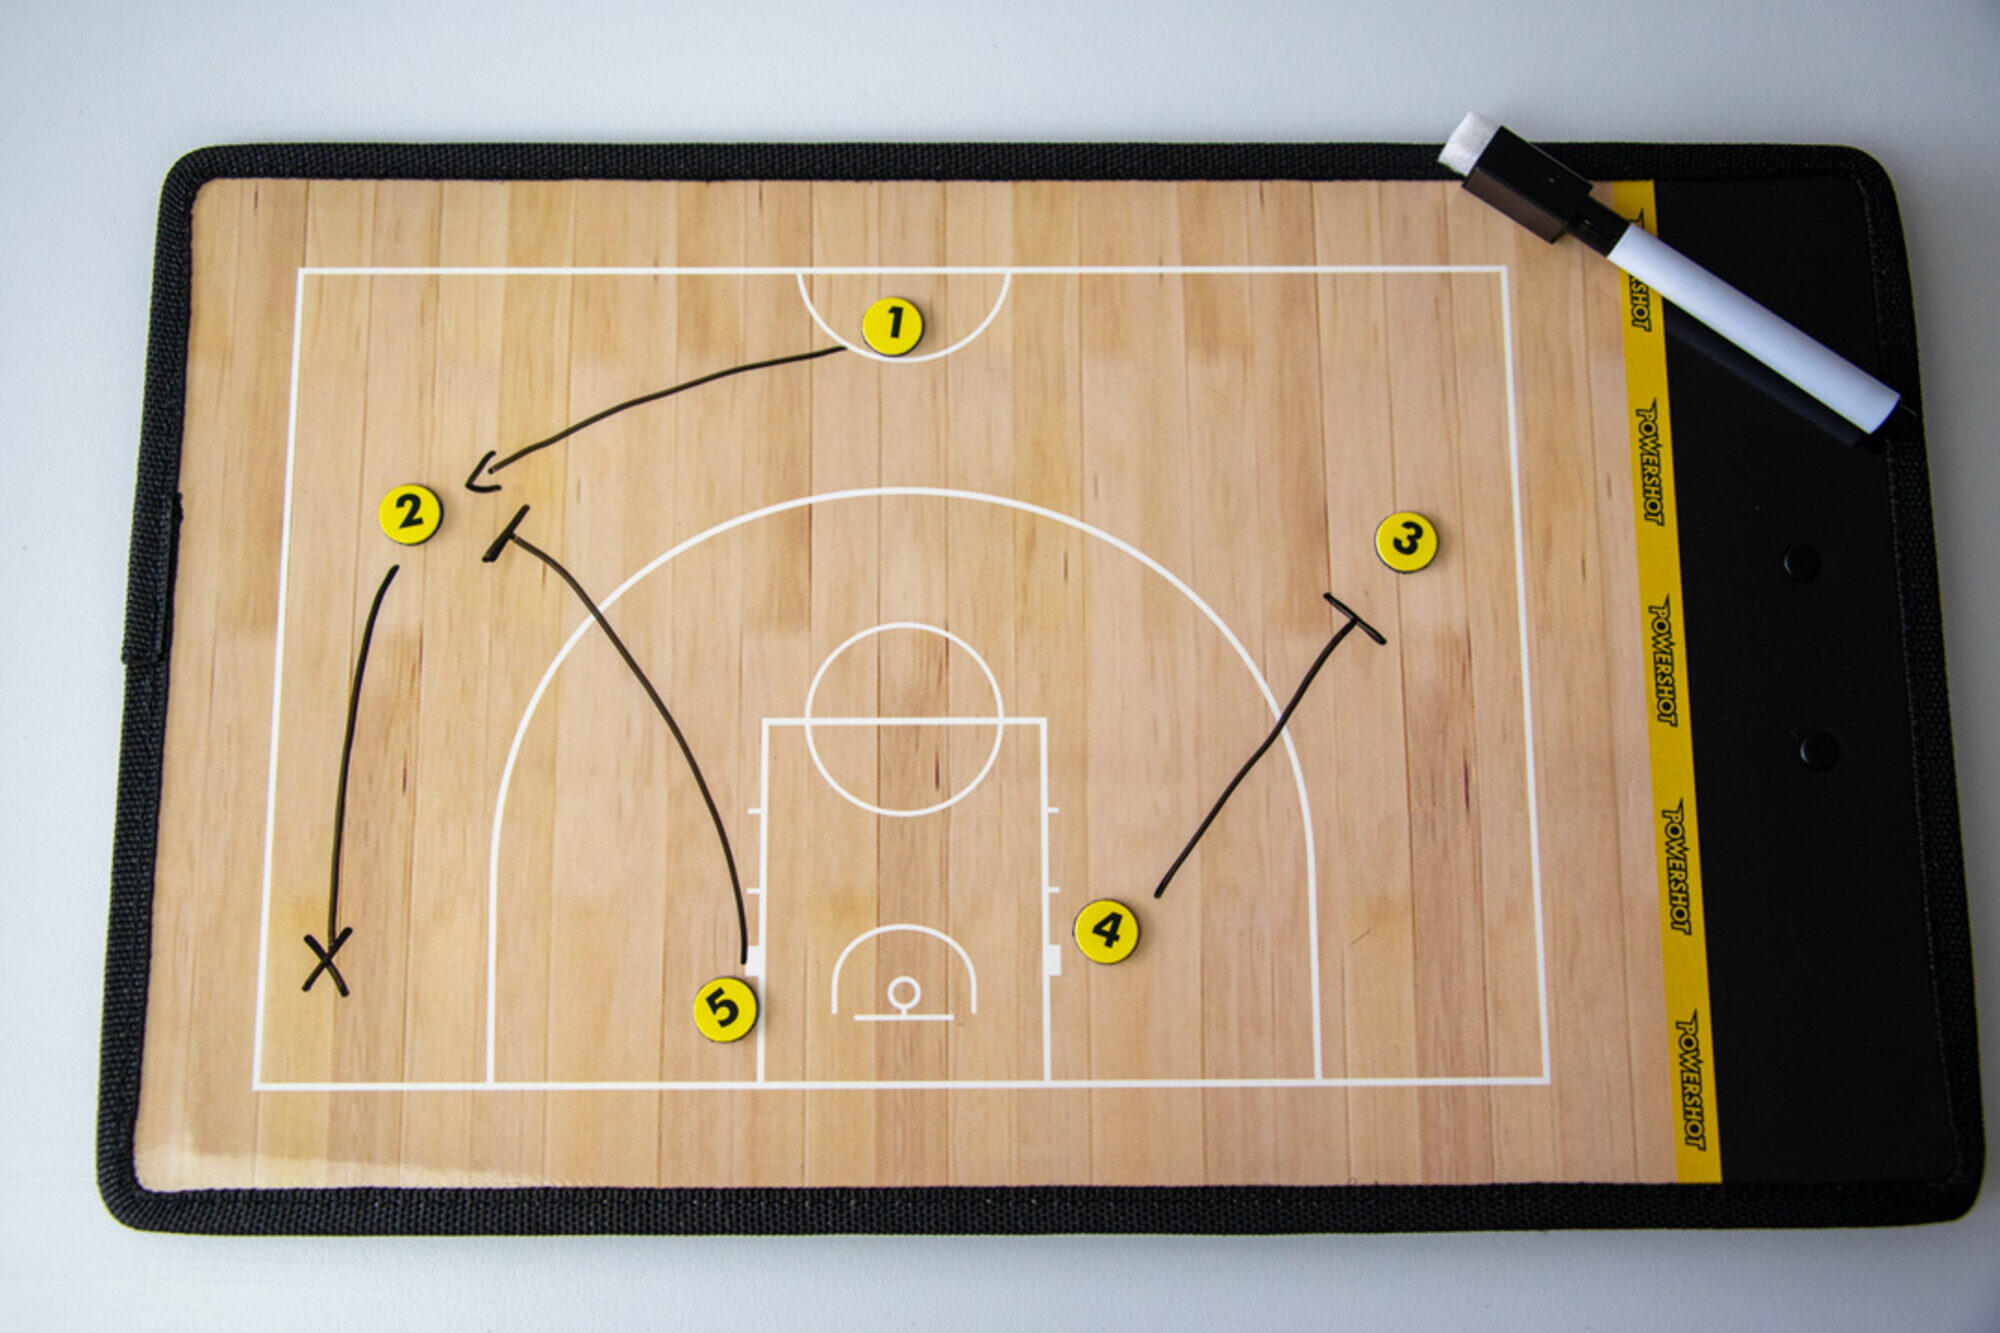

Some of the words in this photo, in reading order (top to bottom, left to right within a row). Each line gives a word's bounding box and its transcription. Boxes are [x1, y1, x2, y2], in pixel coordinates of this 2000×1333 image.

[888, 306, 904, 339] 1
[1636, 397, 1665, 527] POWERSHOT
[396, 493, 424, 529] 2
[1393, 521, 1424, 556] 3
[1649, 593, 1679, 728] POWERSHOT
[1661, 798, 1692, 936] POWERSHOT
[1092, 912, 1123, 949] 4
[705, 987, 739, 1028] 5
[1675, 1008, 1707, 1152] POWERSHOT
